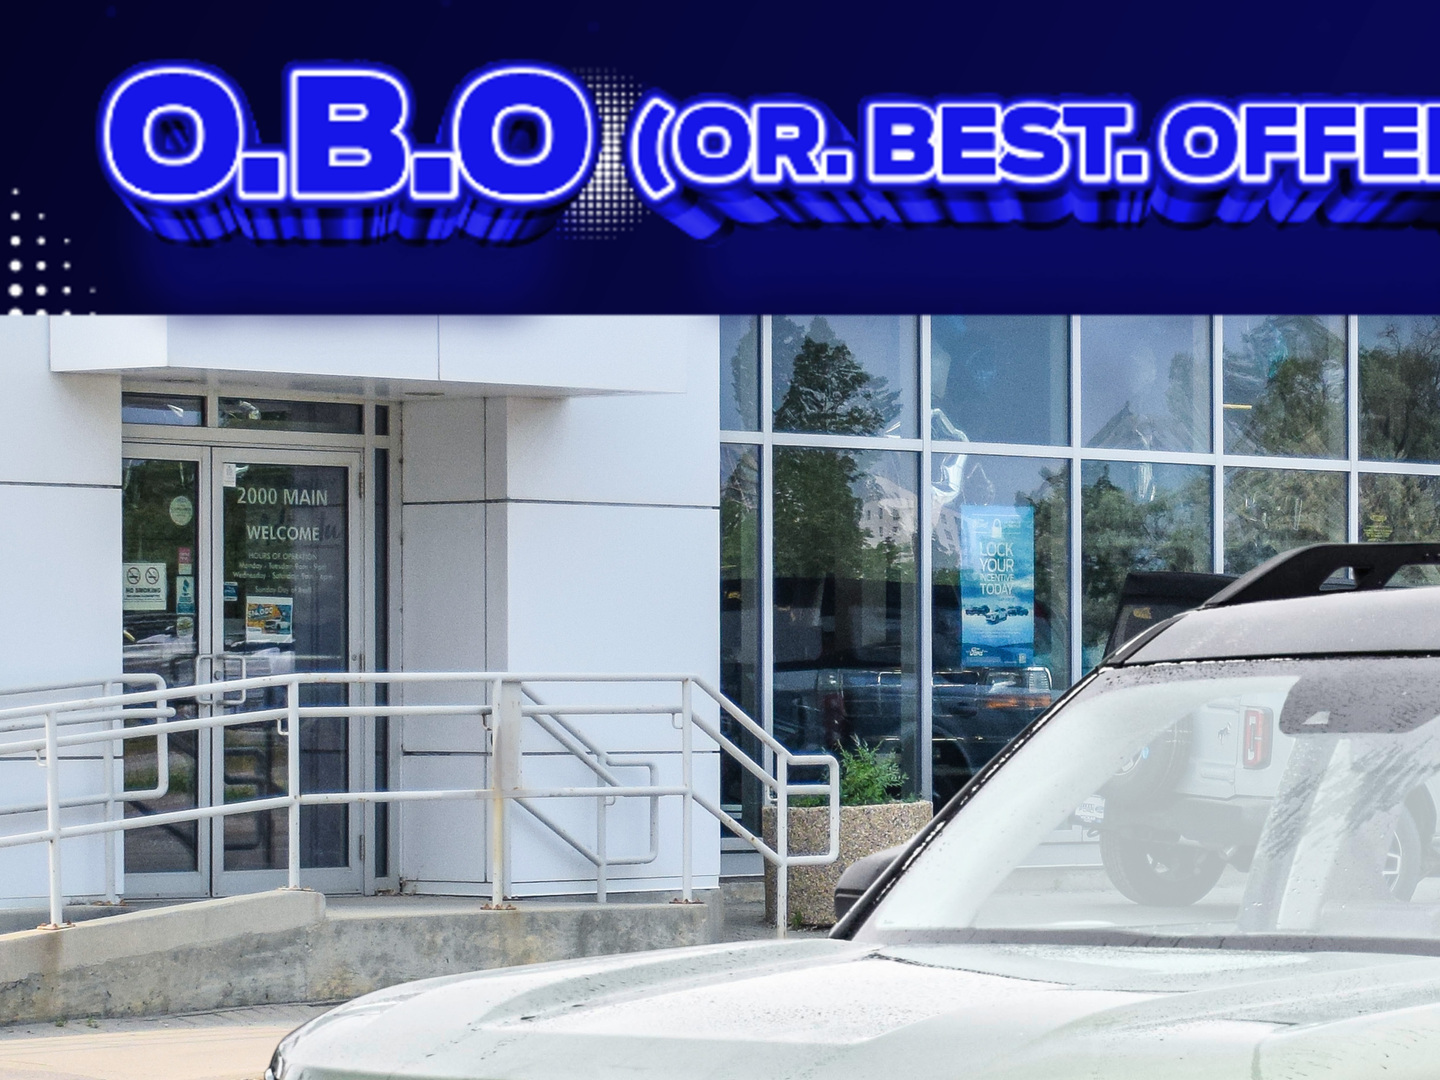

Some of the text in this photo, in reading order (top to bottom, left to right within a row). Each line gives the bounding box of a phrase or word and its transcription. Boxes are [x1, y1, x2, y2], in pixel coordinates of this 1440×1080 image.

[236, 487, 328, 506] 2000 MAIN
[246, 525, 320, 541] WELCOME
[979, 542, 1015, 557] LOCK
[979, 558, 1015, 572] YOUR
[979, 583, 1014, 595] TODAY
